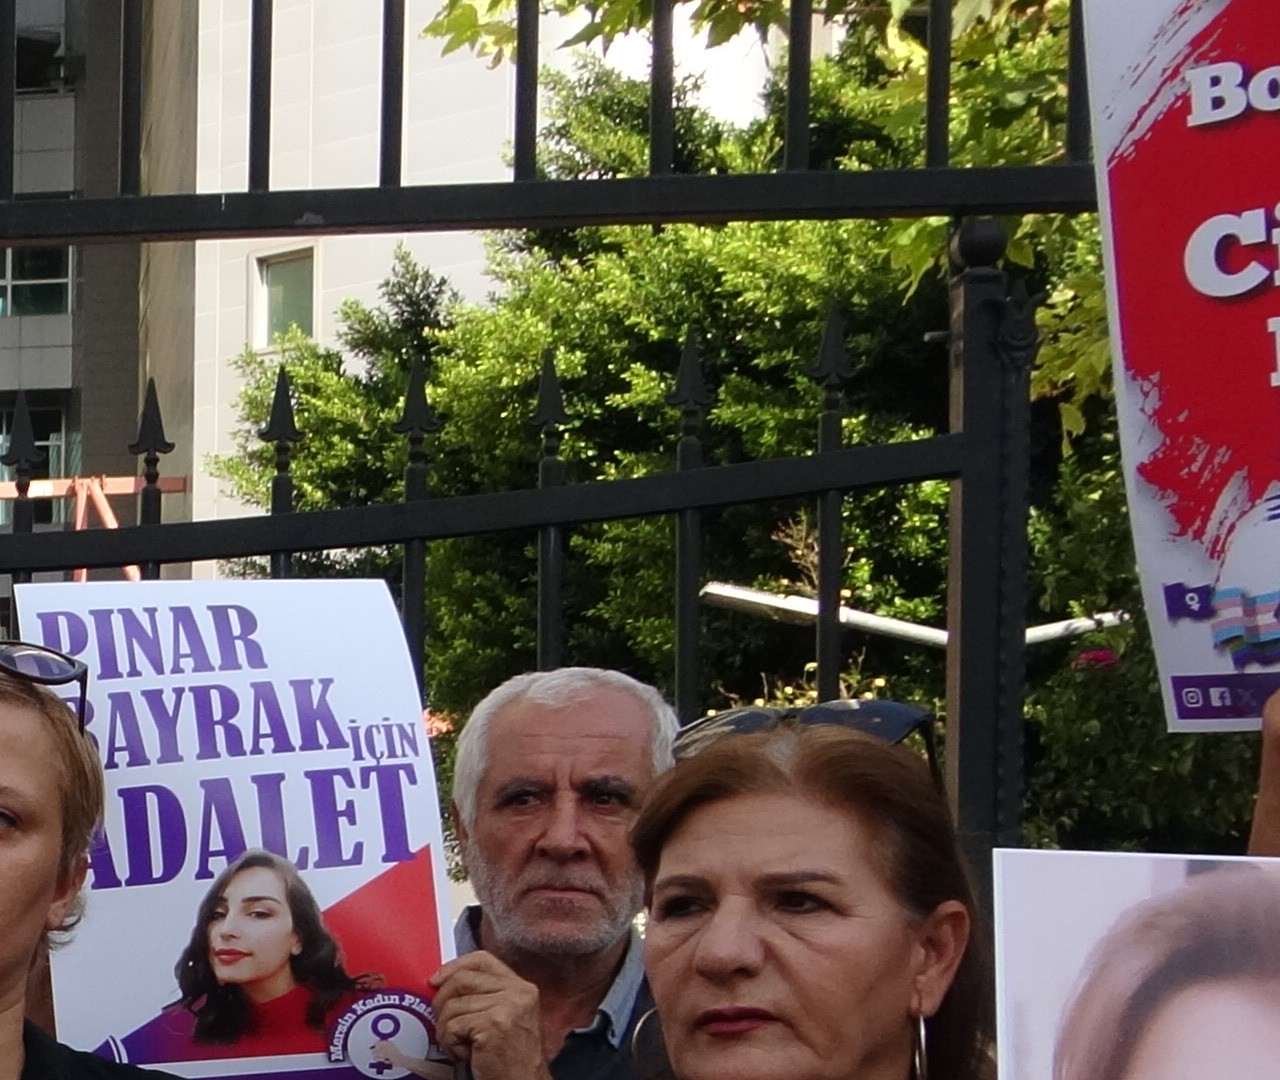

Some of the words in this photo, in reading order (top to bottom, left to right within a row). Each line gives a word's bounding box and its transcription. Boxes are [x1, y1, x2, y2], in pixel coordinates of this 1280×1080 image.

[36, 604, 268, 681] PINAR
[329, 1012, 357, 1061] Mersin
[352, 994, 400, 1015] Kadın
